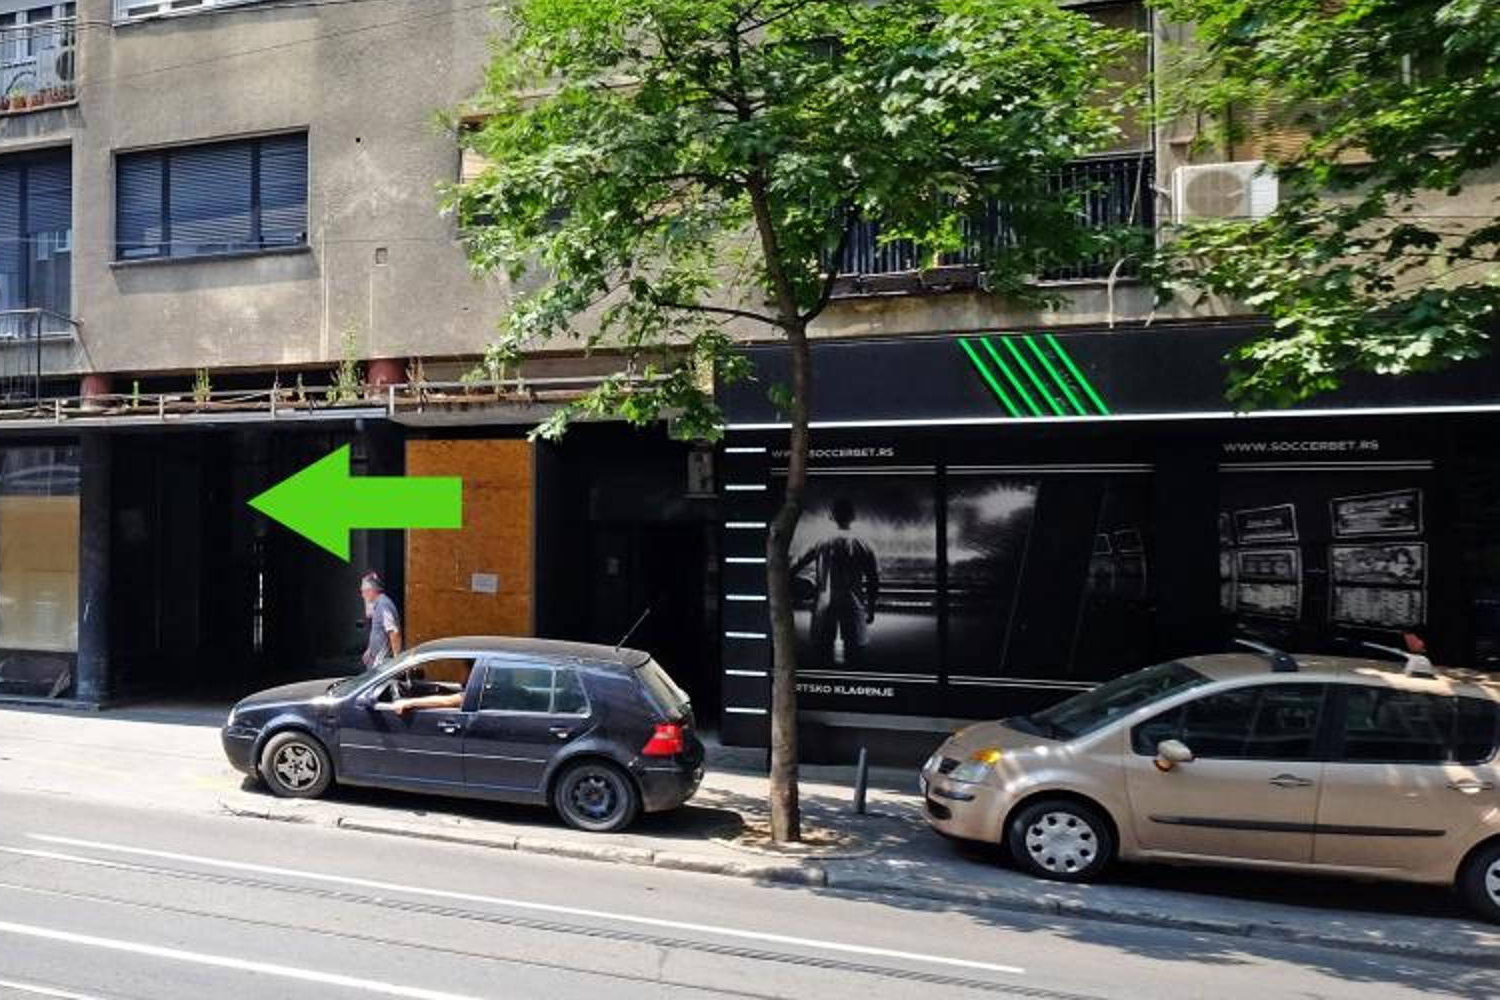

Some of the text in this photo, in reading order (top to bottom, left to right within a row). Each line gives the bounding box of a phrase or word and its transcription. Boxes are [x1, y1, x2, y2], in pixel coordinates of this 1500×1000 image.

[1222, 439, 1379, 453] WWW.SOCCERBET.RS
[771, 447, 895, 458] WWSOCCERBET.RS
[795, 683, 833, 695] RTSKO
